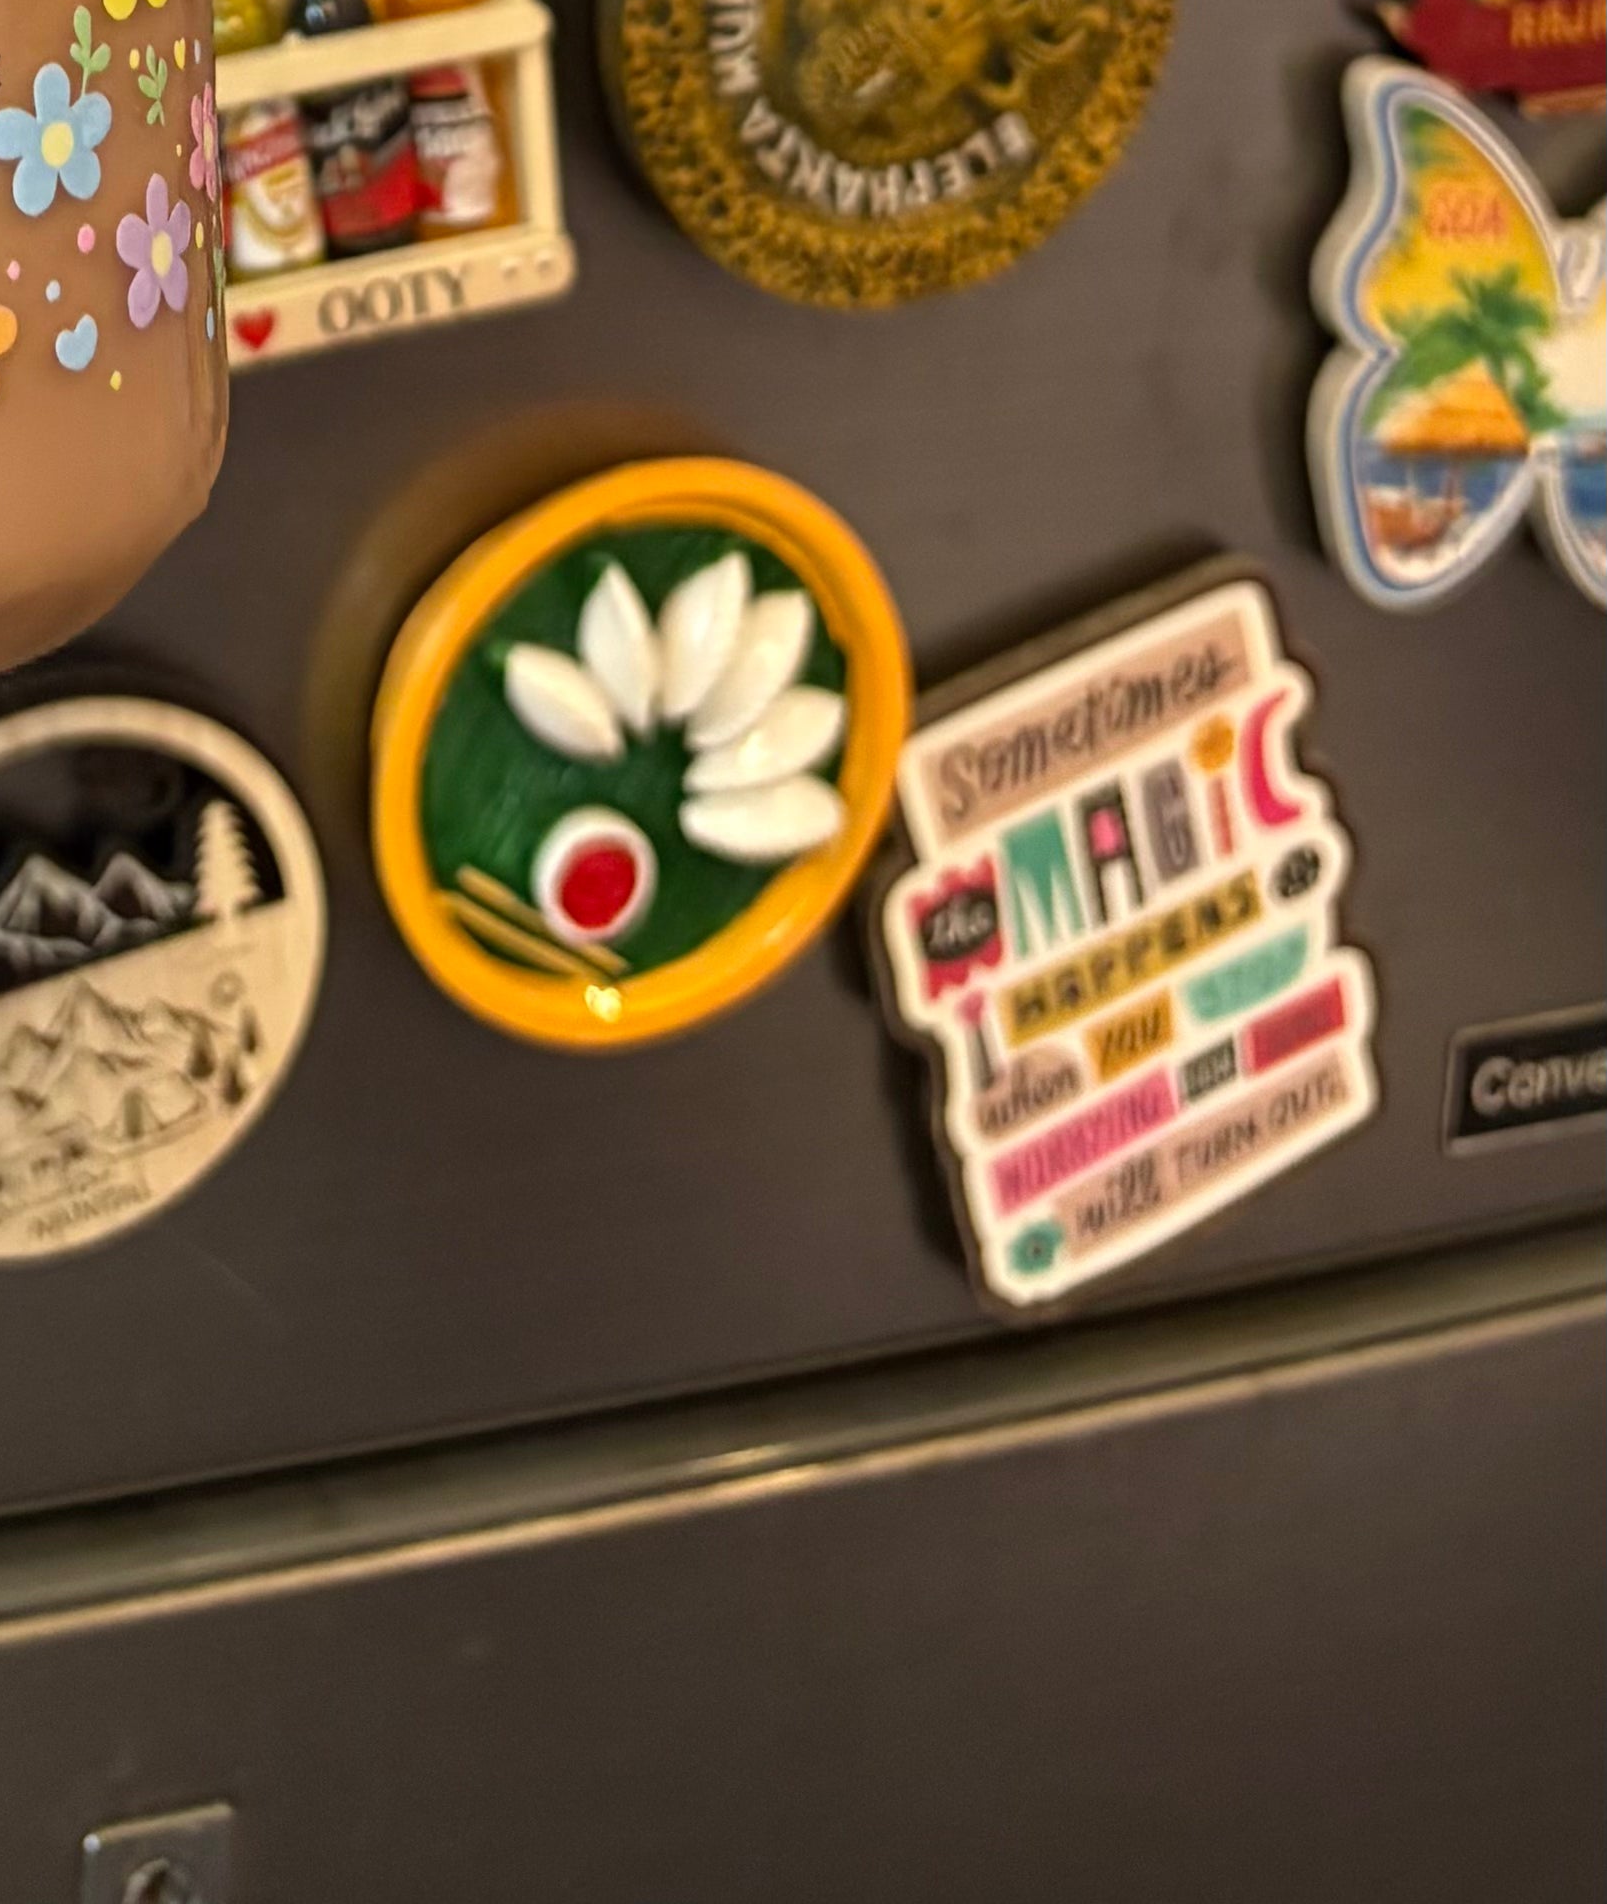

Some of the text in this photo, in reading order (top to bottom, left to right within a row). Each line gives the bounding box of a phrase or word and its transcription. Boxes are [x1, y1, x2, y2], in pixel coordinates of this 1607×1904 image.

[740, 96, 1037, 218] ELEPHANTA
[318, 266, 471, 337] OOTY
[939, 644, 1238, 820] Sometimes
